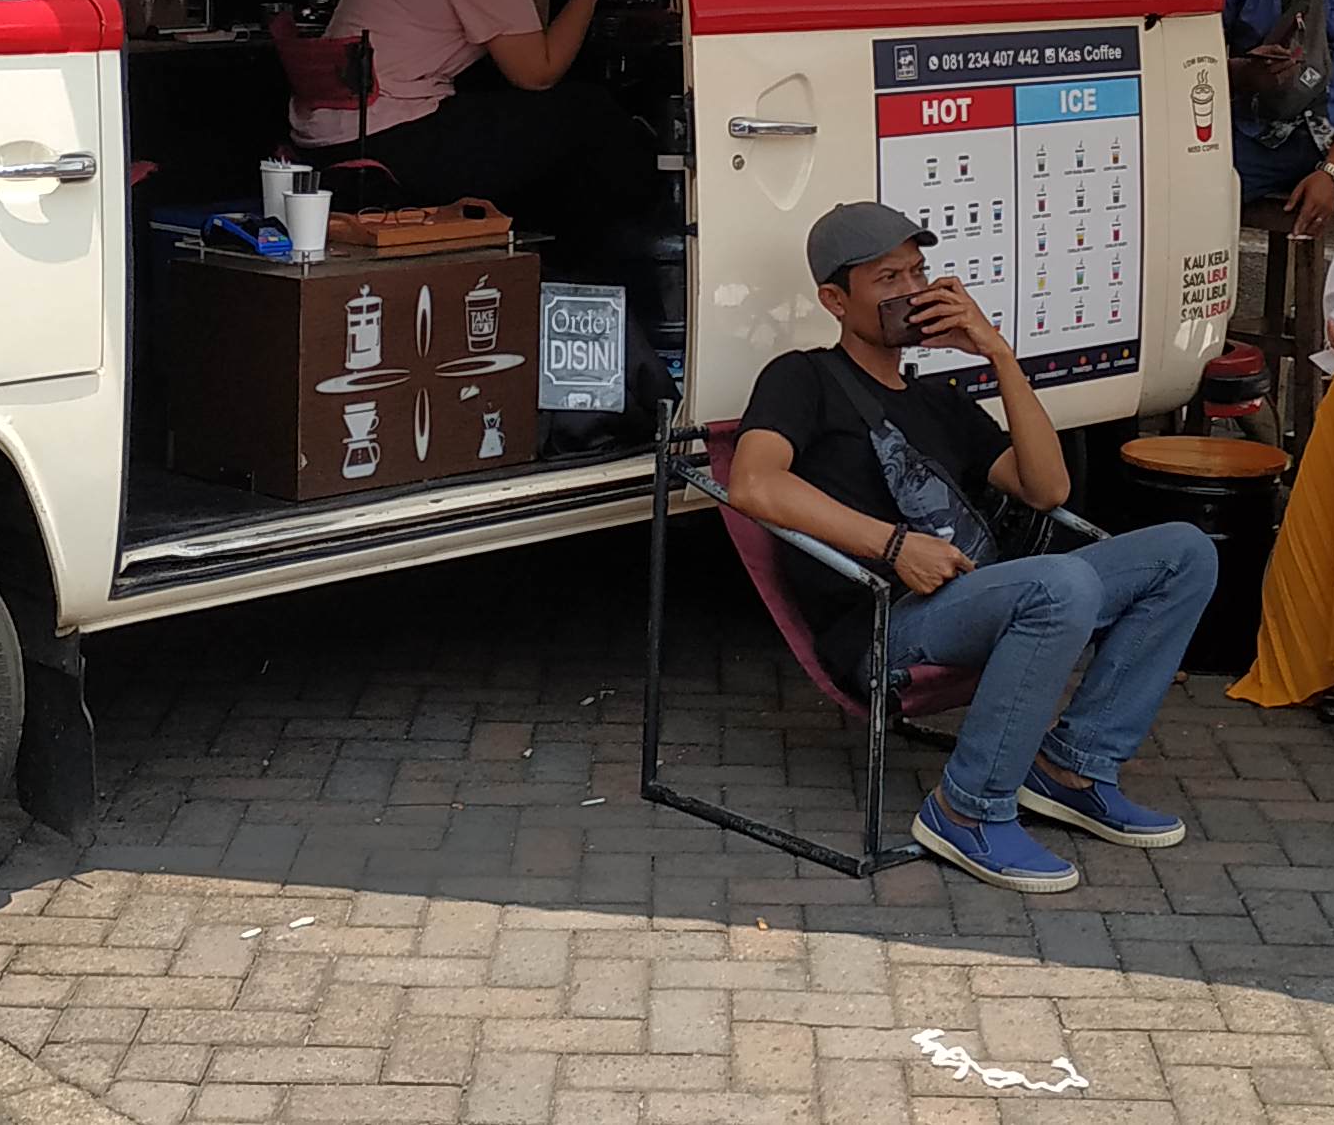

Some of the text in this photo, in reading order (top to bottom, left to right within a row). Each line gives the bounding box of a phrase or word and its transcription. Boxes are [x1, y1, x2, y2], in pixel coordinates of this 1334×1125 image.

[942, 44, 1122, 70] 081 234 407 442 Kas Coffee
[1060, 88, 1097, 113] ICE
[921, 97, 972, 126] HOT
[1183, 254, 1206, 272] KAU
[1182, 272, 1206, 289] SAYA
[1182, 288, 1205, 306] KAU
[470, 309, 495, 324] TAKE
[551, 308, 615, 335] Order
[1180, 306, 1204, 324] SAYA
[550, 340, 616, 371] DISINI
